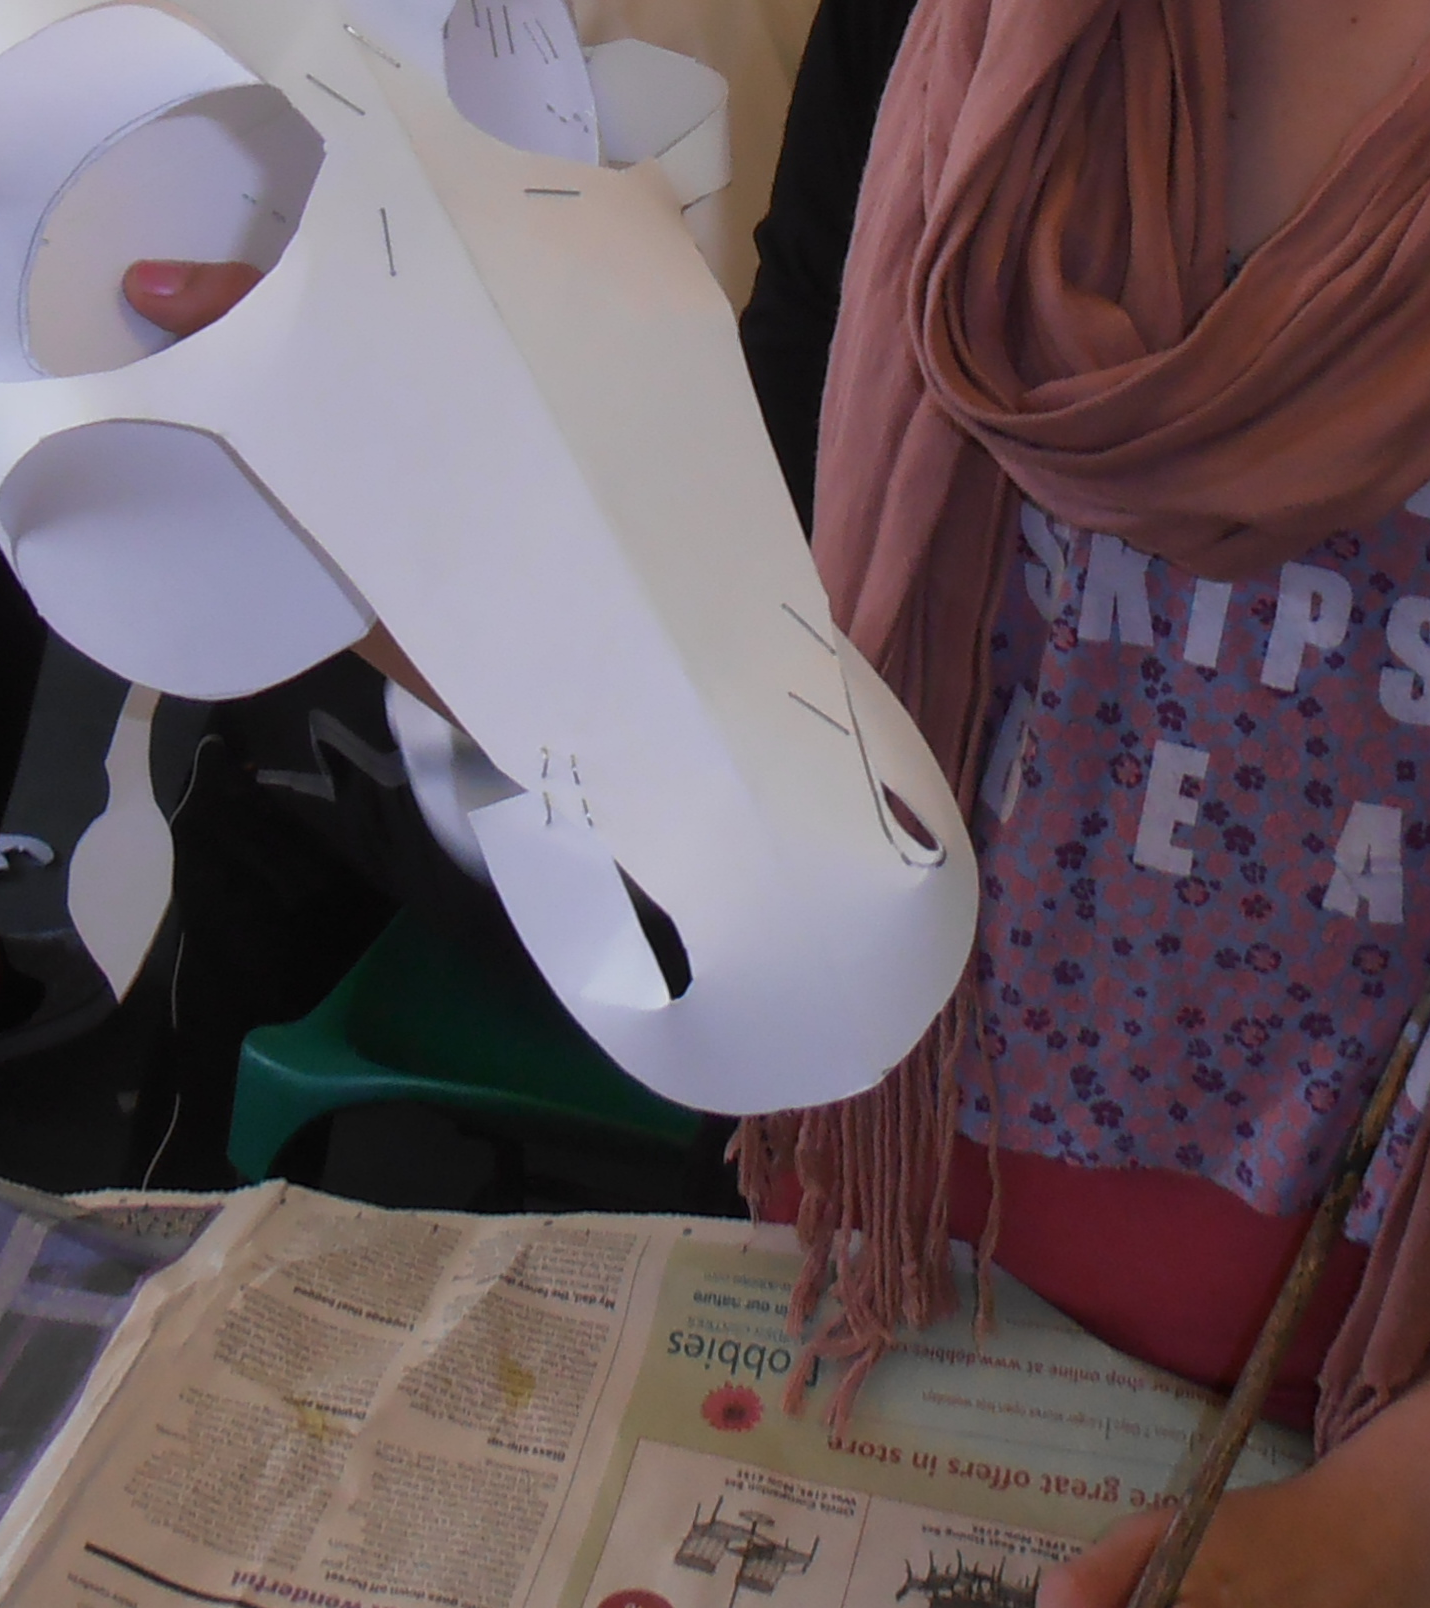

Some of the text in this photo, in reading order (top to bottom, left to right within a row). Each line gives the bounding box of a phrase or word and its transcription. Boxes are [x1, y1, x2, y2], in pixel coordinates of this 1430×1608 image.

[599, 1295, 617, 1312] My
[693, 1291, 743, 1310] nature
[747, 1299, 770, 1313] our
[1025, 1359, 1045, 1378] at
[1049, 1362, 1102, 1388] online
[1104, 1368, 1146, 1394] shop
[826, 1434, 903, 1466] store
[911, 1451, 939, 1479] in
[946, 1457, 1031, 1491] offers
[1038, 1475, 1120, 1504] great
[230, 1569, 363, 1608] wonderful
